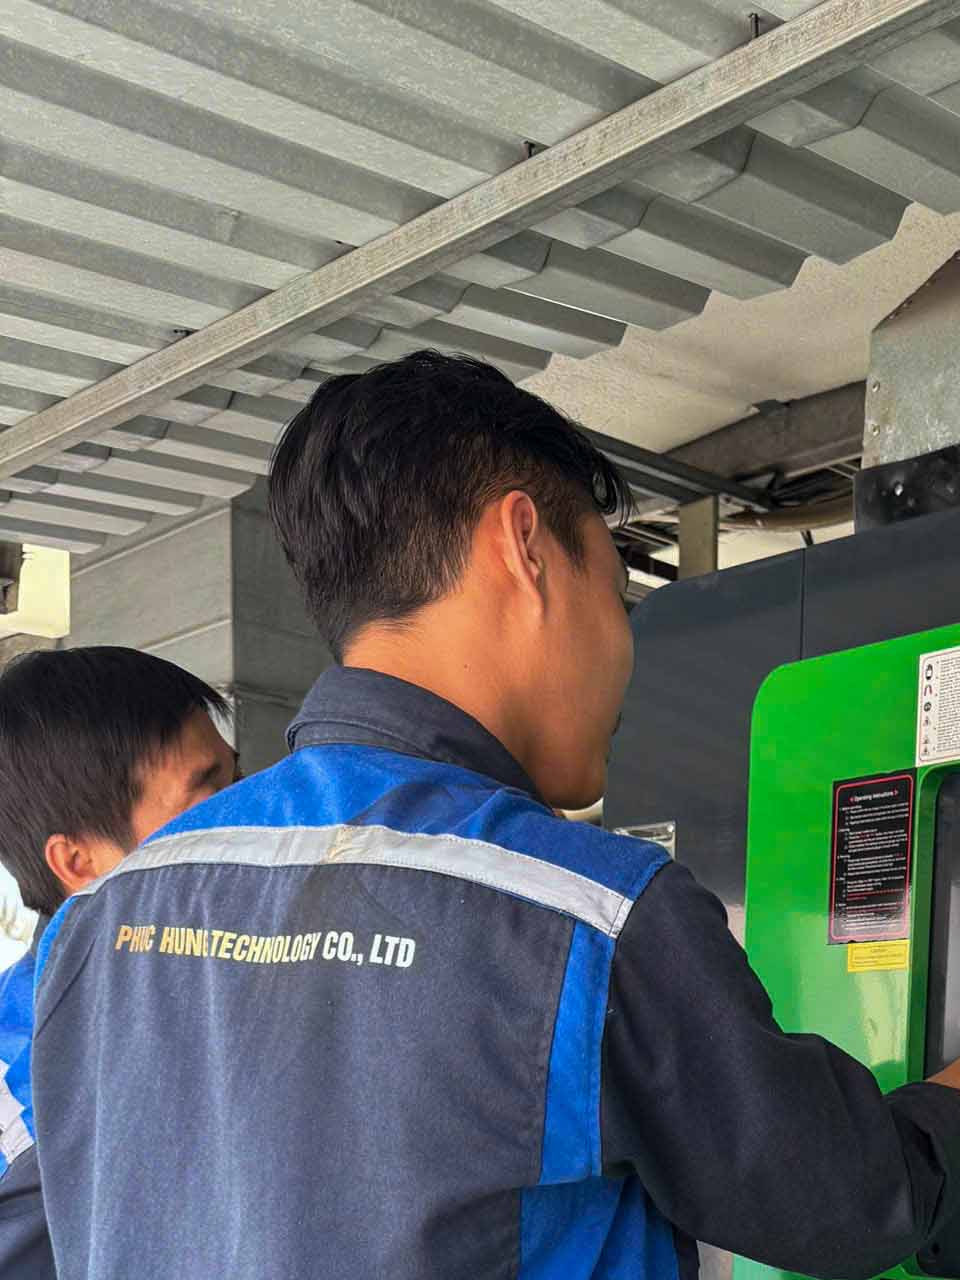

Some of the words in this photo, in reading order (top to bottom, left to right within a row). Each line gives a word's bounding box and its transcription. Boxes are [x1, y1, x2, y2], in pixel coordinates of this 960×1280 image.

[210, 930, 321, 964] TECHNOLOGY
[321, 931, 364, 966] CO.,
[369, 934, 416, 968] LTD
